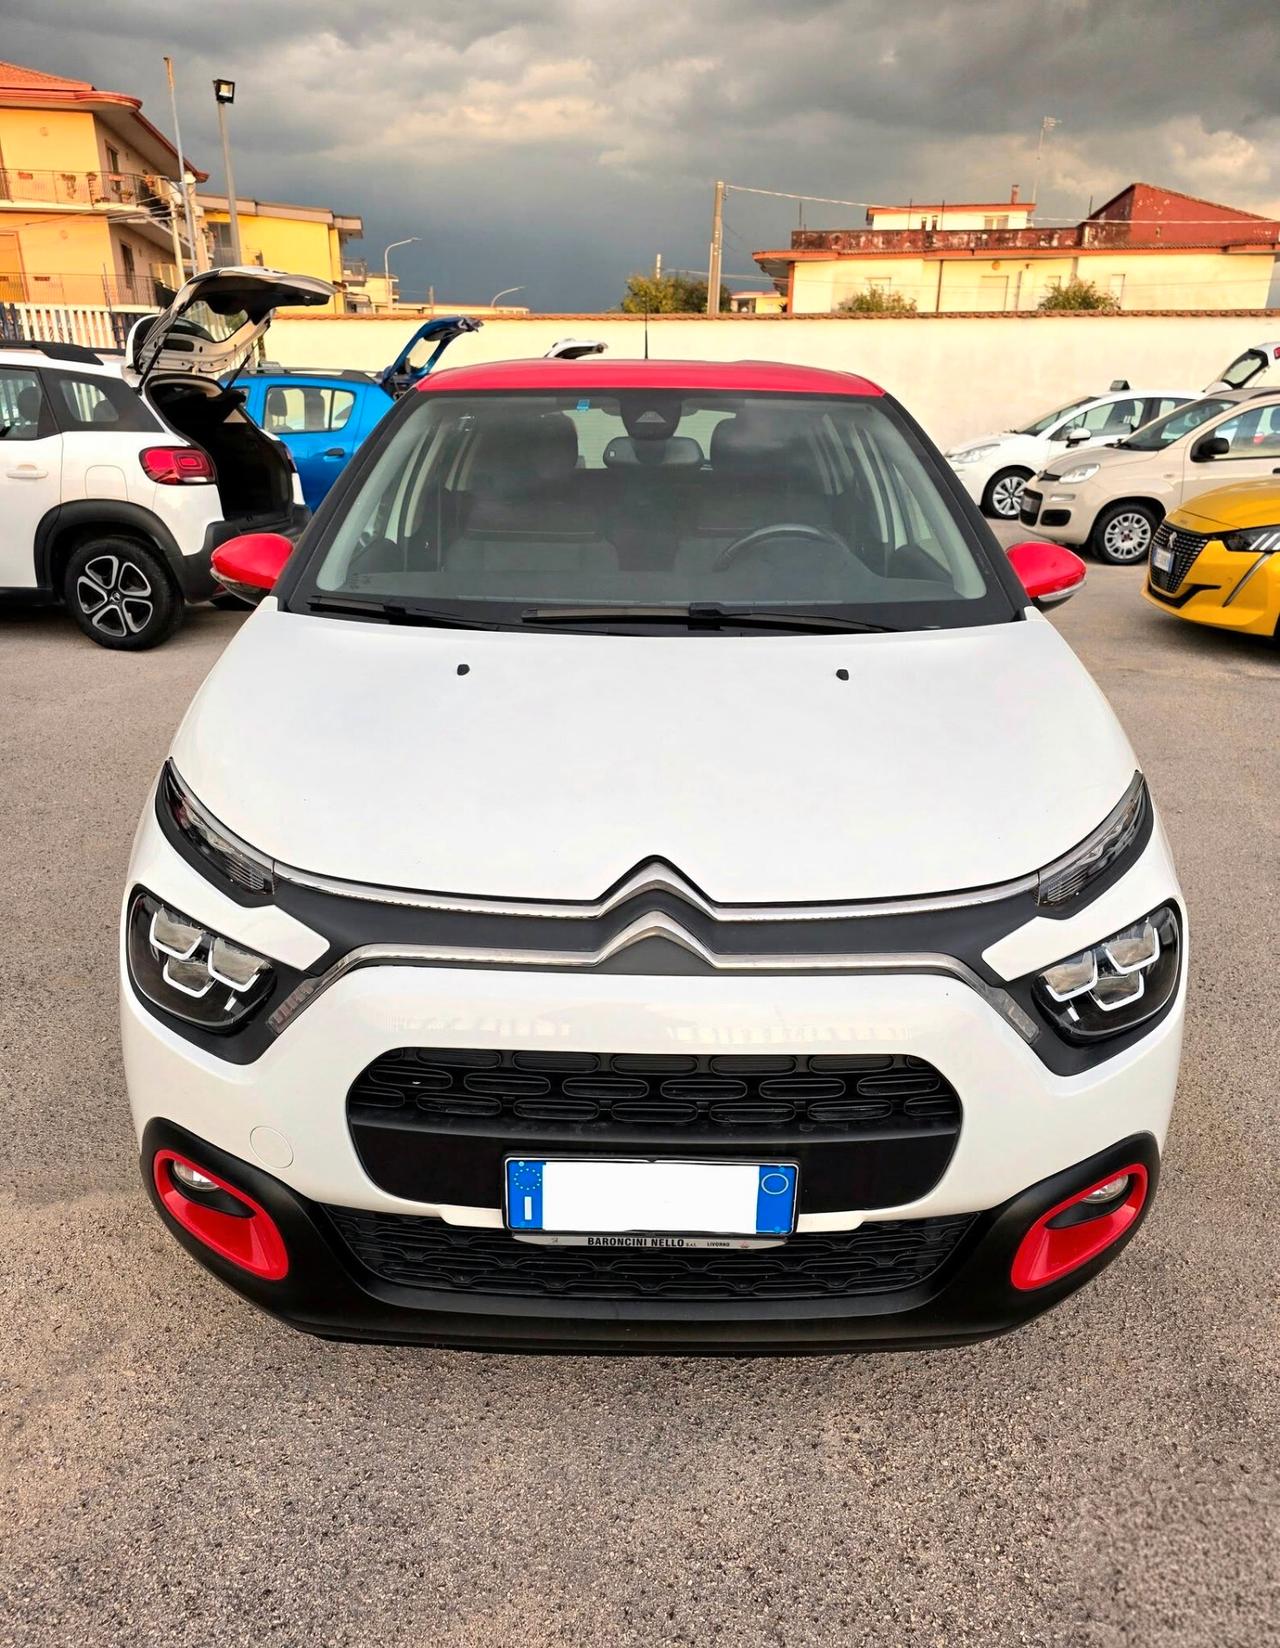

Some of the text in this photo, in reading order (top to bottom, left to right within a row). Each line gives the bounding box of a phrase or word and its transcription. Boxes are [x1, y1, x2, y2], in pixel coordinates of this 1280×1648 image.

[524, 1196, 532, 1220] I
[587, 1237, 647, 1246] BARONCINI
[651, 1238, 685, 1247] NELLO
